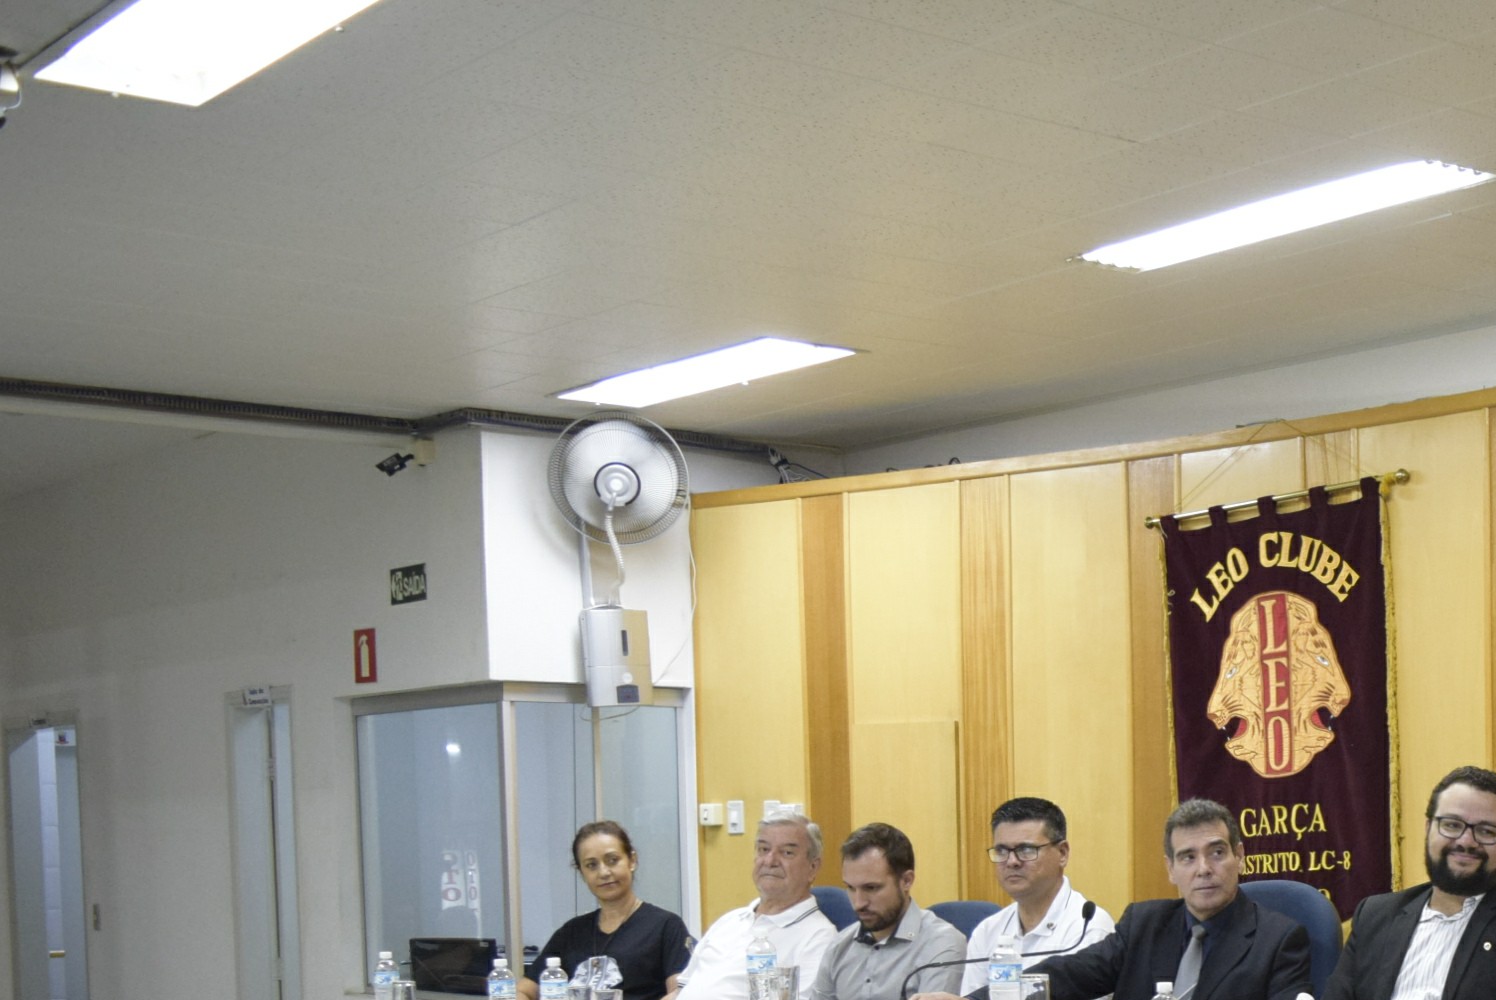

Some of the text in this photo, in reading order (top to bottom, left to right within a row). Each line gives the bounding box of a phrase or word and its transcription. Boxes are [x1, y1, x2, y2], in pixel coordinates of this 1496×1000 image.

[1190, 531, 1360, 622] LEO CLUBE
[1240, 803, 1327, 840] GARÇA
[1241, 850, 1351, 875] ISTRITO LC-8
